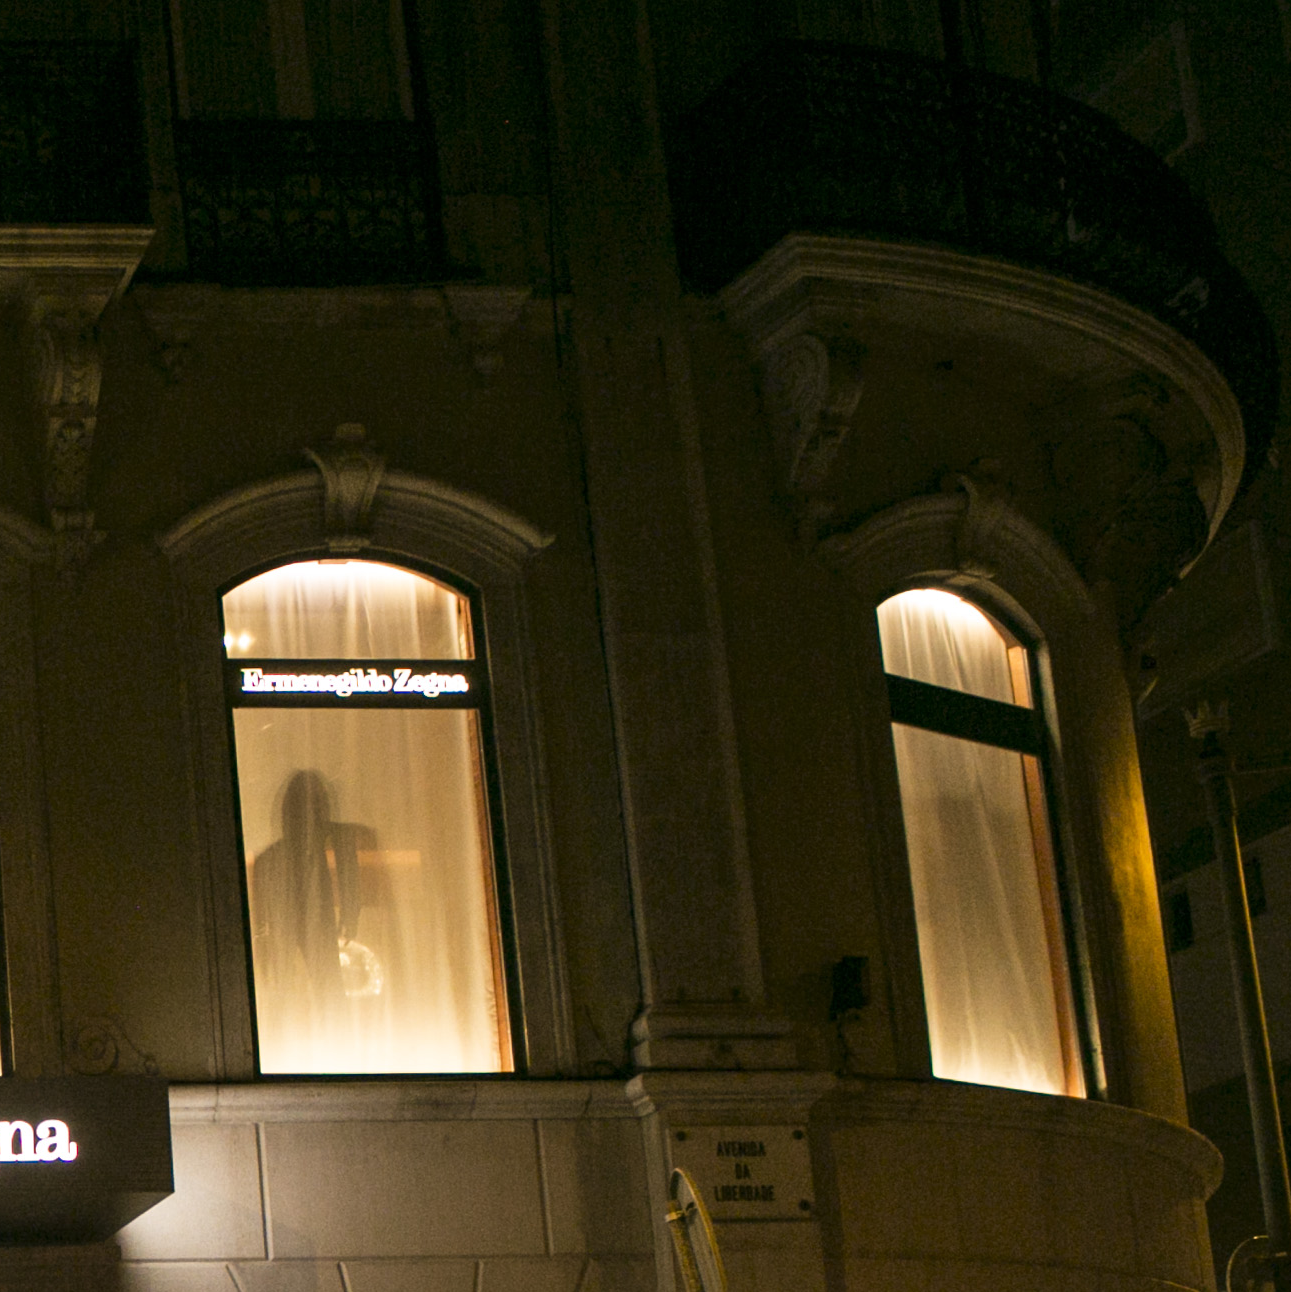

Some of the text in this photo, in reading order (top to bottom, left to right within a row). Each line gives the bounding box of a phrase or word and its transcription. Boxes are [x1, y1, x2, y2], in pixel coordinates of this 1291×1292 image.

[241, 668, 469, 698] Ermenegildo Zegna
[717, 1141, 767, 1157] AVENIDA
[735, 1163, 751, 1179] DA
[713, 1185, 775, 1202] LIBERDADE
